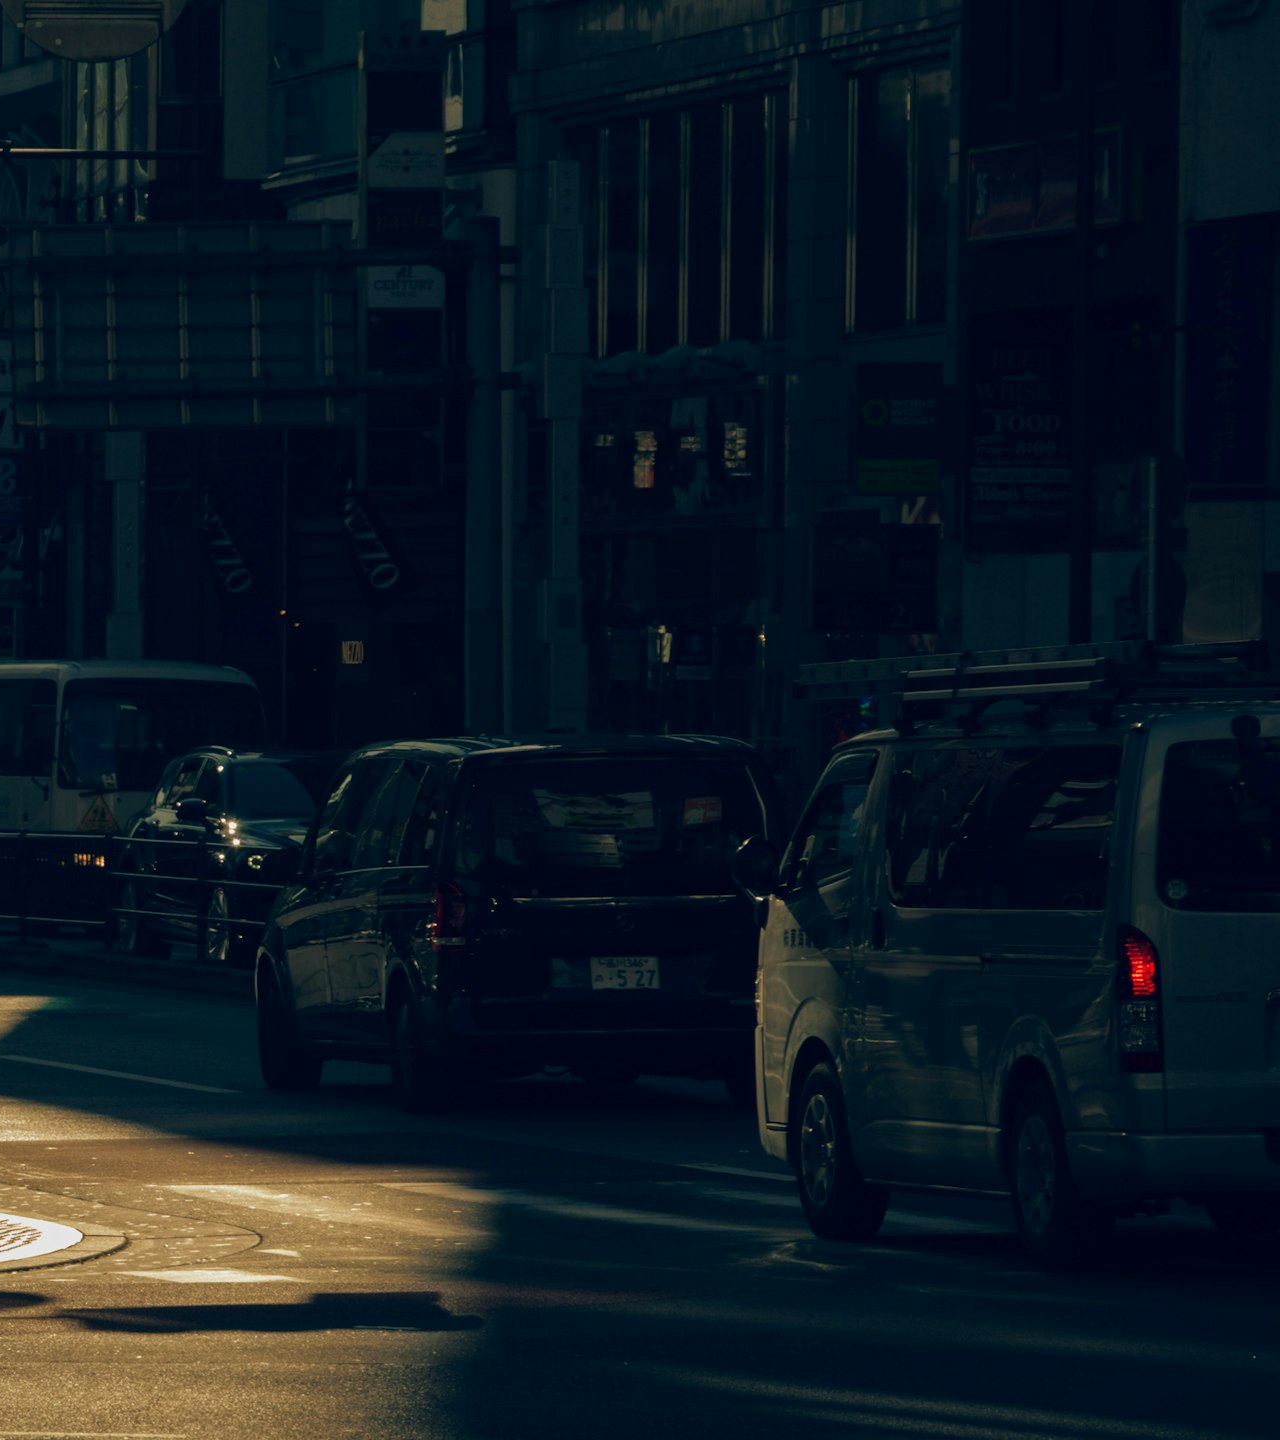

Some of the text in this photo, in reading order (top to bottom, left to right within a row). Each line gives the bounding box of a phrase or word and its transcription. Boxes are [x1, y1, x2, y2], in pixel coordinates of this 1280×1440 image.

[373, 279, 435, 291] CENTURY
[975, 382, 1066, 401] WHISKY
[994, 414, 1063, 432] FOOD
[1015, 440, 1057, 456] 8:00
